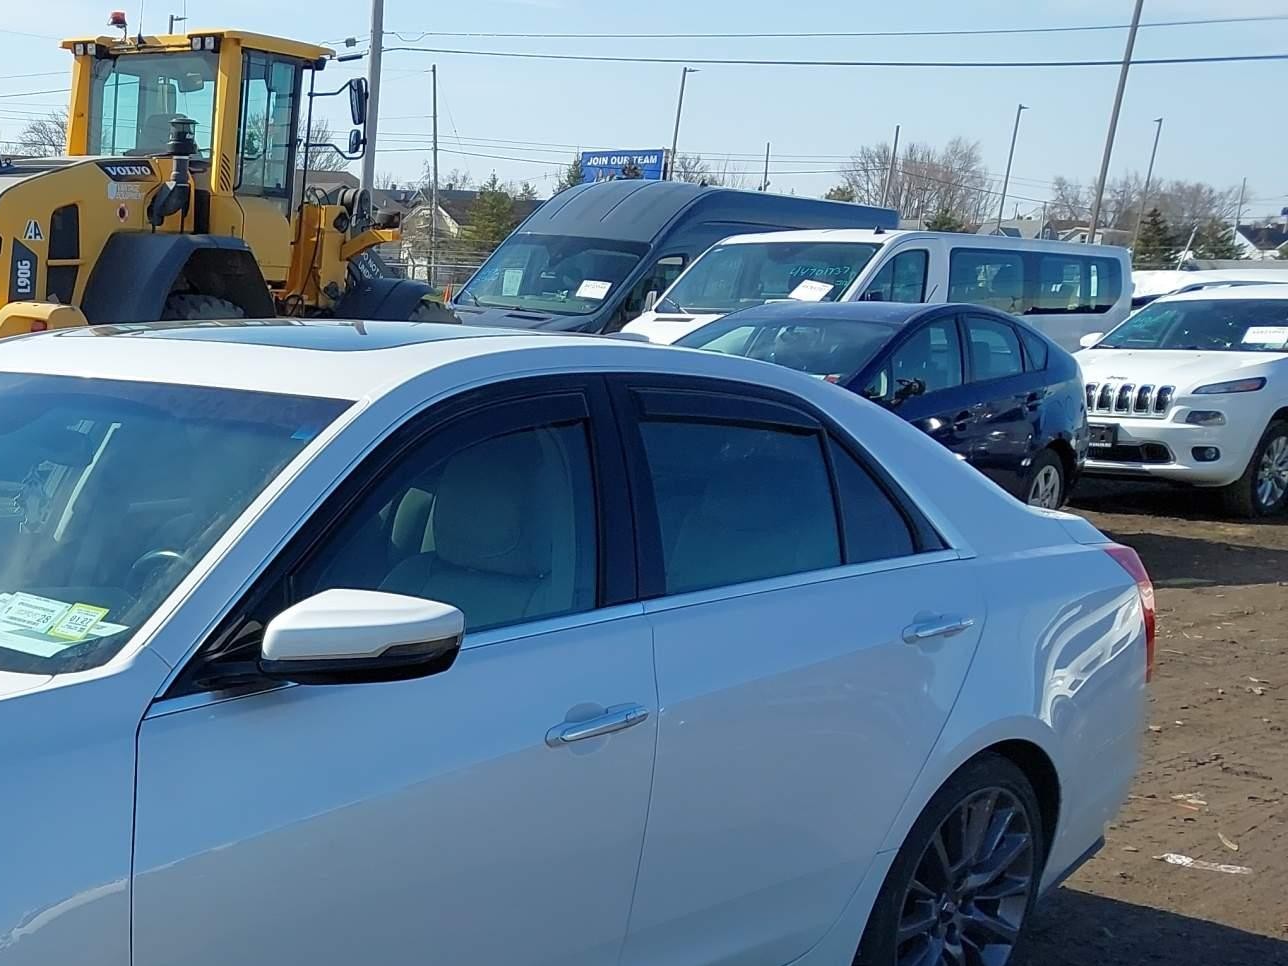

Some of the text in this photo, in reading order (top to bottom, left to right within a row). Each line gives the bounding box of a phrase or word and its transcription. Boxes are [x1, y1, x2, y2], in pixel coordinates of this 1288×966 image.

[587, 156, 609, 166] JOIN
[632, 154, 658, 164] TEAM
[105, 166, 152, 176] VOLVO
[17, 260, 31, 293] L90G
